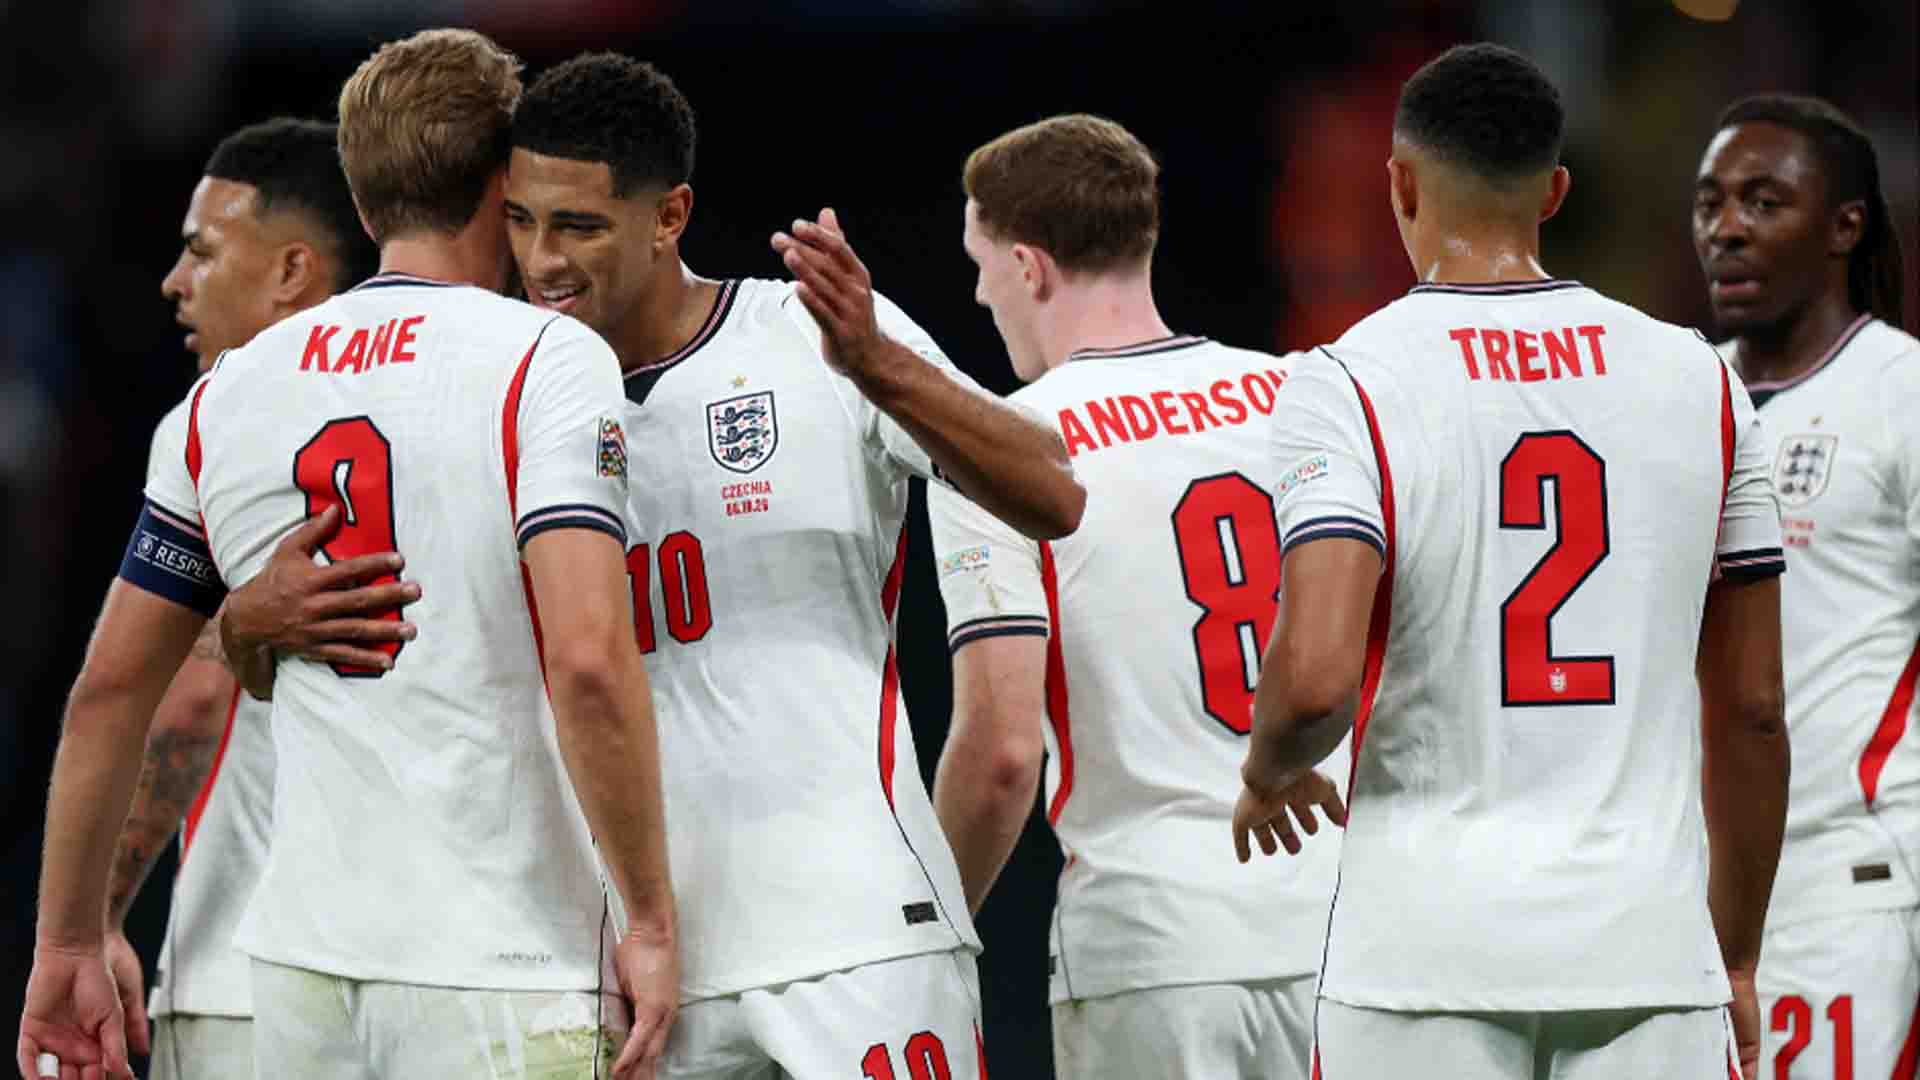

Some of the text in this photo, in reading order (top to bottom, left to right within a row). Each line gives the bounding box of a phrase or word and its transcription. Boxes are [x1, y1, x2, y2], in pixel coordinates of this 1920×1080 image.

[300, 315, 425, 374] KANE
[1448, 325, 1607, 382] TRENT
[722, 480, 772, 499] CZECHIA
[625, 529, 713, 655] 10
[1171, 471, 1282, 736] 8
[1499, 430, 1616, 707] 2
[1770, 993, 1854, 1080] 21
